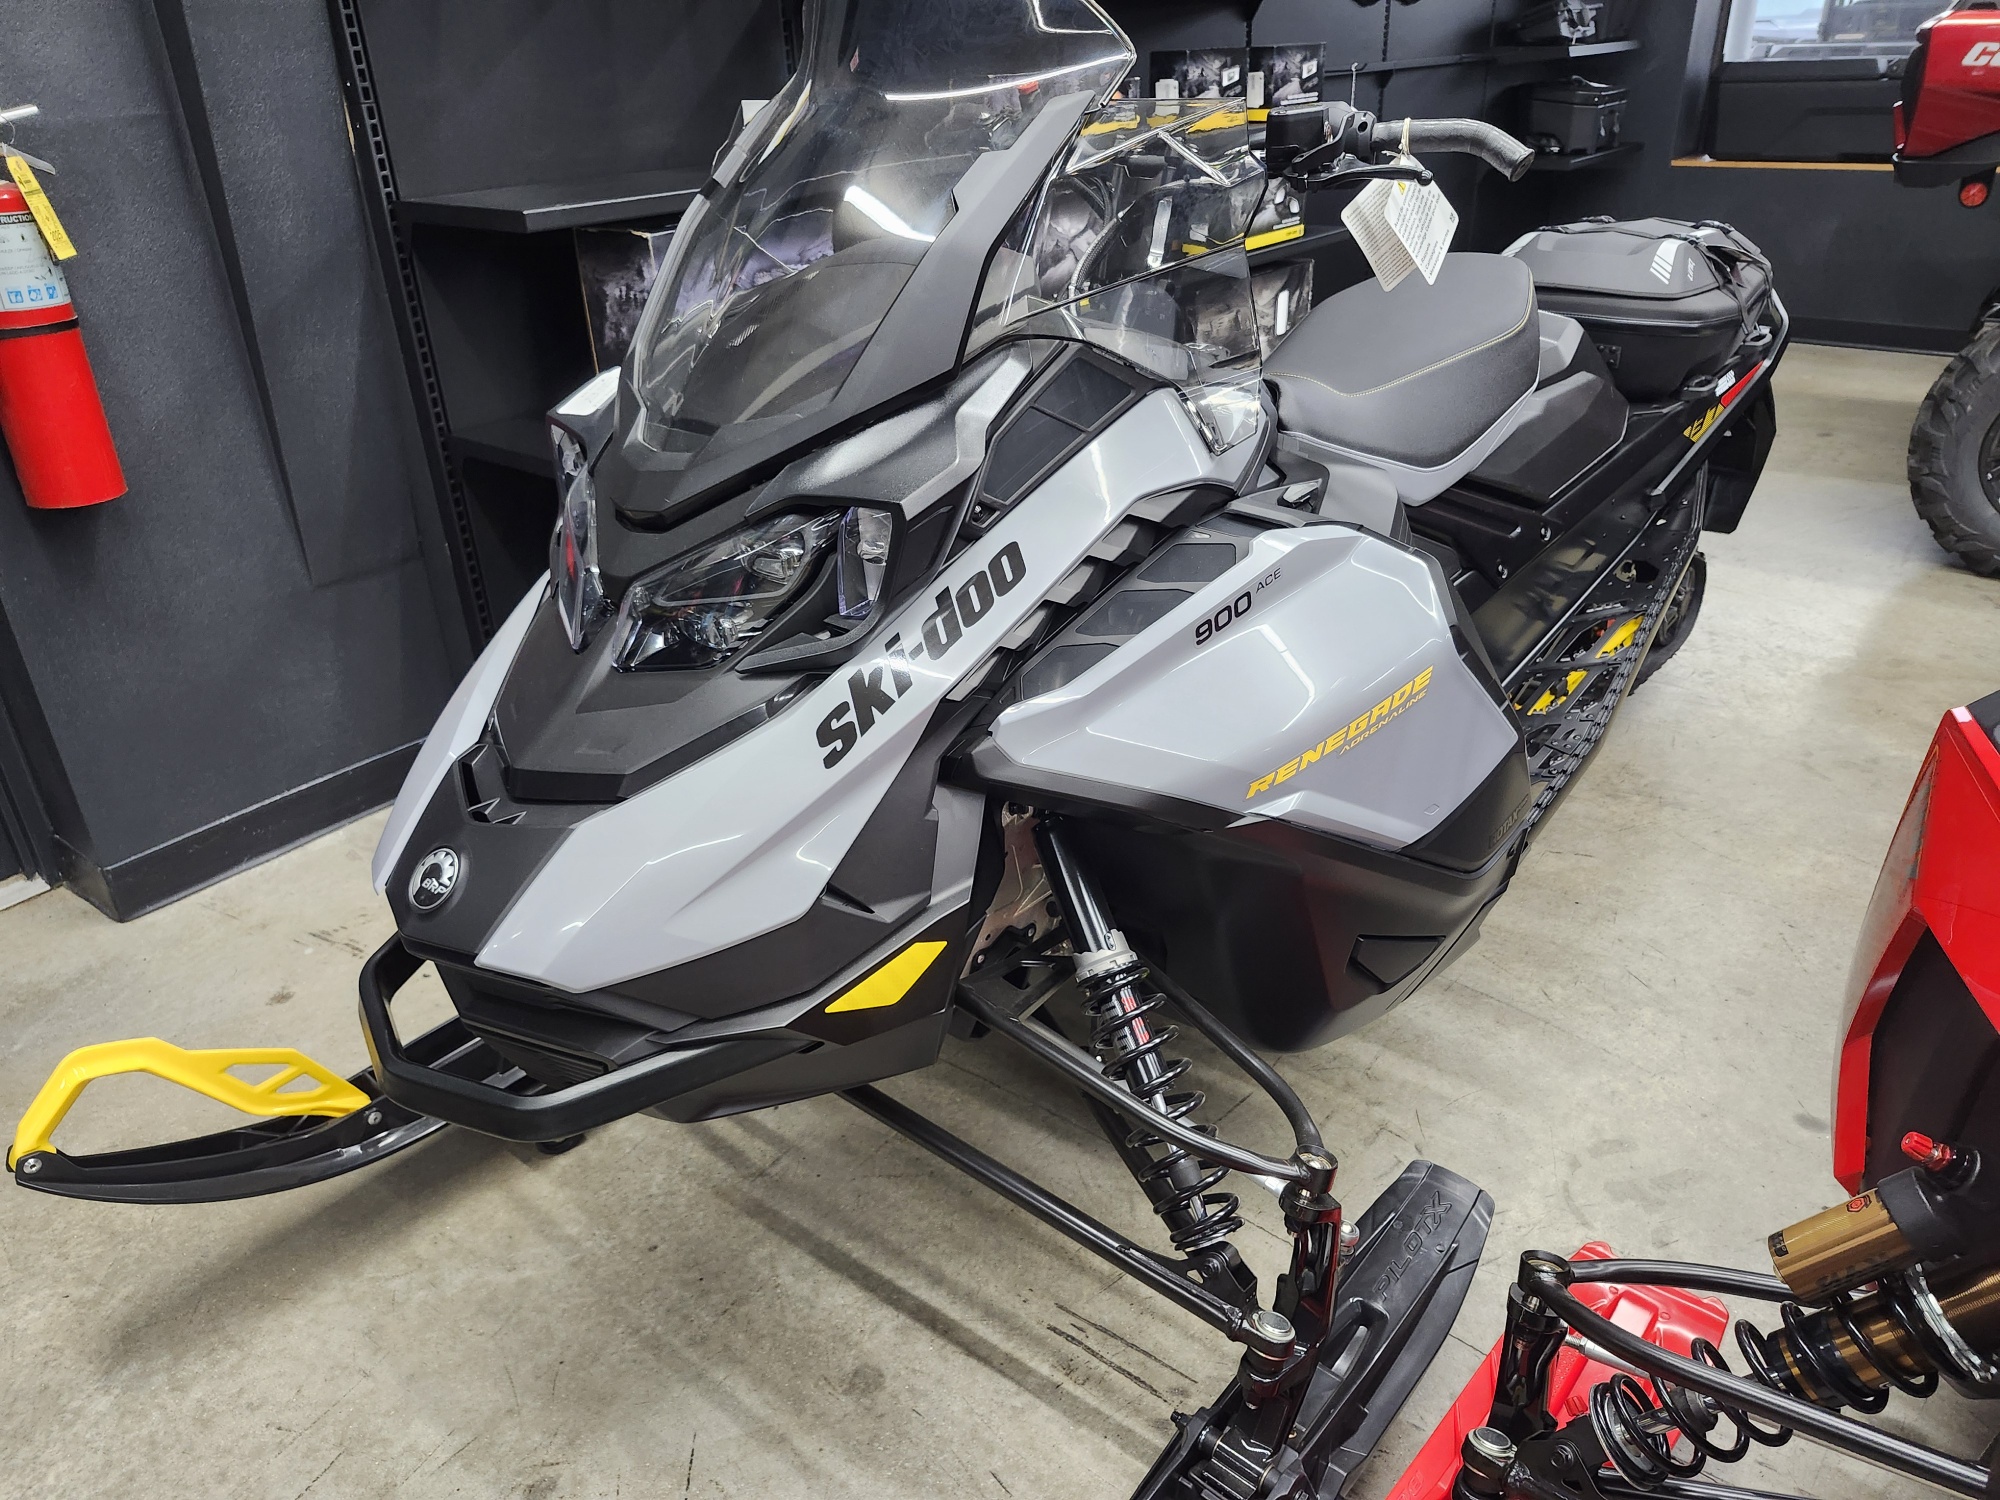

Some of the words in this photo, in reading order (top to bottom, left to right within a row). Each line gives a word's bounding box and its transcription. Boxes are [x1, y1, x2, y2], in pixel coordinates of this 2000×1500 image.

[1195, 591, 1252, 646] 900
[1255, 567, 1282, 594] ACE
[1246, 665, 1433, 800] RENEGADE
[1339, 688, 1427, 756] ADRENALINE
[421, 877, 448, 895] BRP
